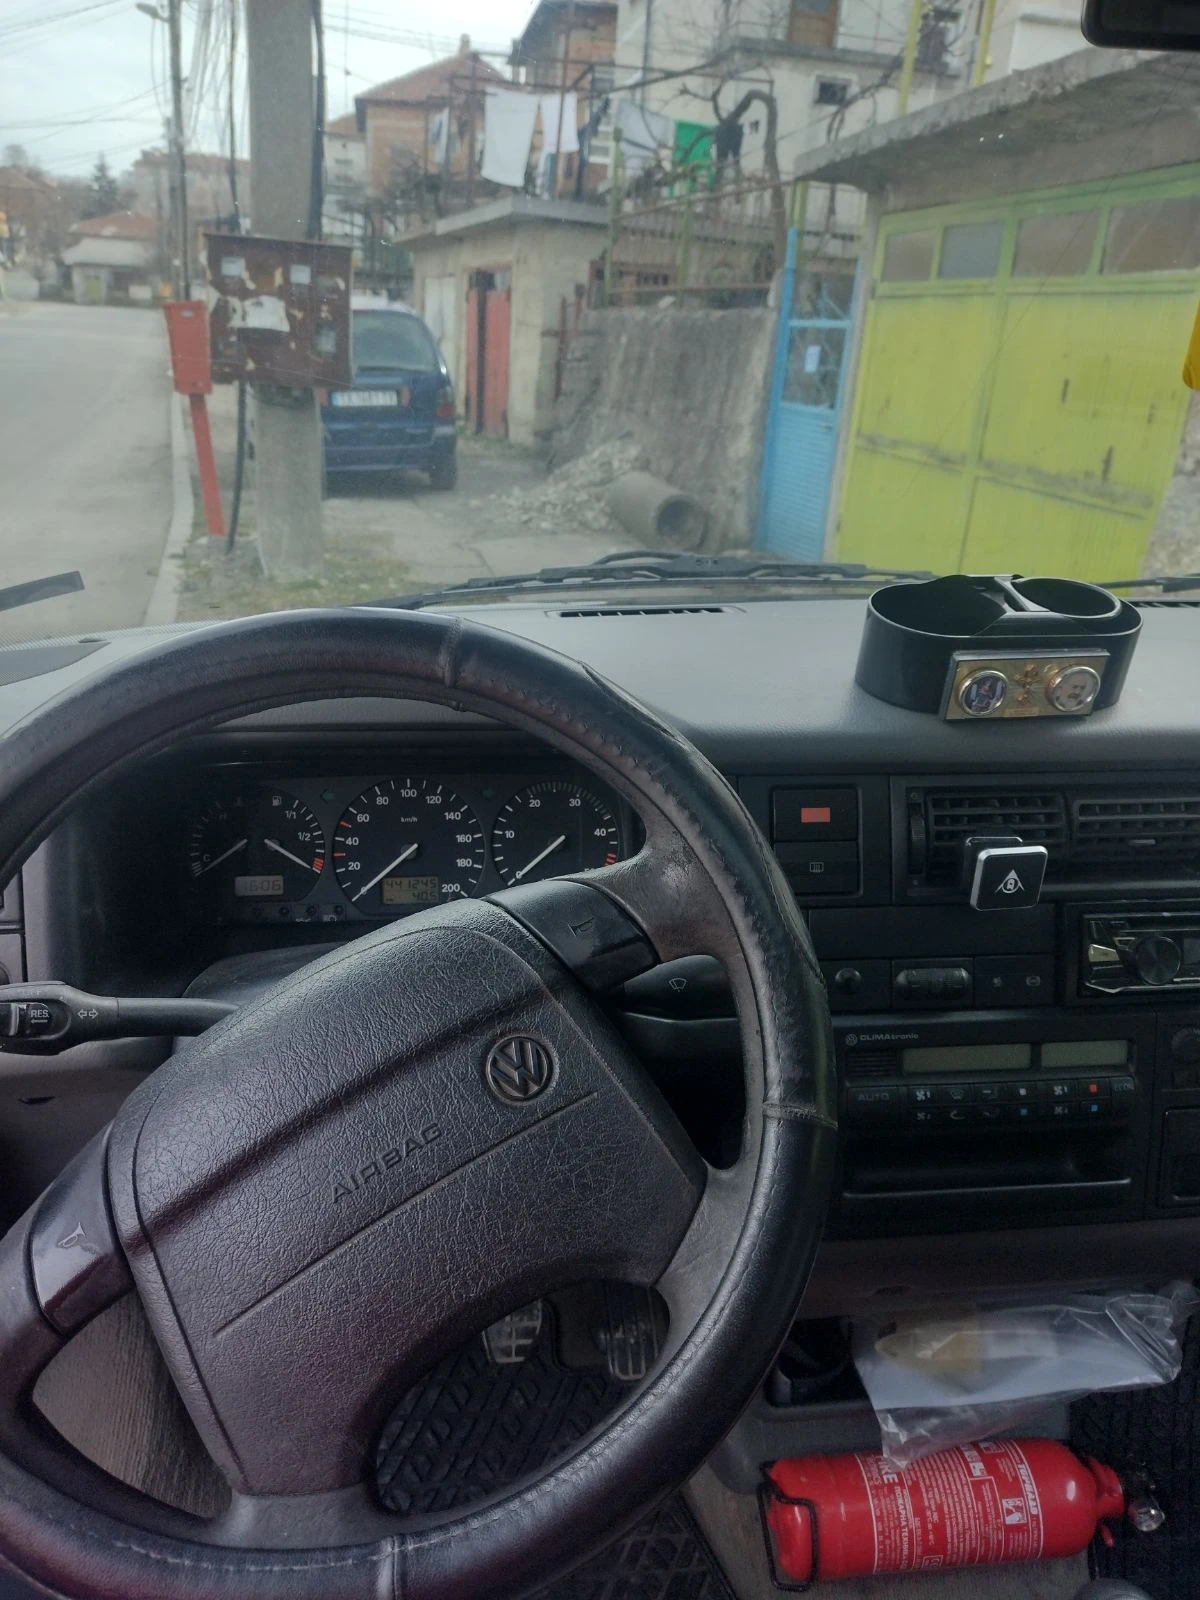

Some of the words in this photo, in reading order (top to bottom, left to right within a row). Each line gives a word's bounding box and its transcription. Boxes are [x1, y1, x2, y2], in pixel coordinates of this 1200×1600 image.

[400, 789, 417, 798] 100
[376, 797, 389, 805] 80
[425, 796, 441, 804] 120
[529, 799, 541, 808] 20
[569, 799, 581, 807] 30
[285, 810, 297, 820] 1/1
[357, 814, 370, 822] 60
[444, 811, 461, 820] 140
[298, 832, 311, 841] 1/2
[505, 831, 515, 839] 10
[594, 828, 606, 836] 40
[346, 837, 359, 846] 40
[456, 834, 472, 843] 160
[348, 862, 361, 871] 20
[456, 859, 472, 867] 180
[441, 883, 460, 893] 200
[331, 1121, 442, 1204] AIRBAG
